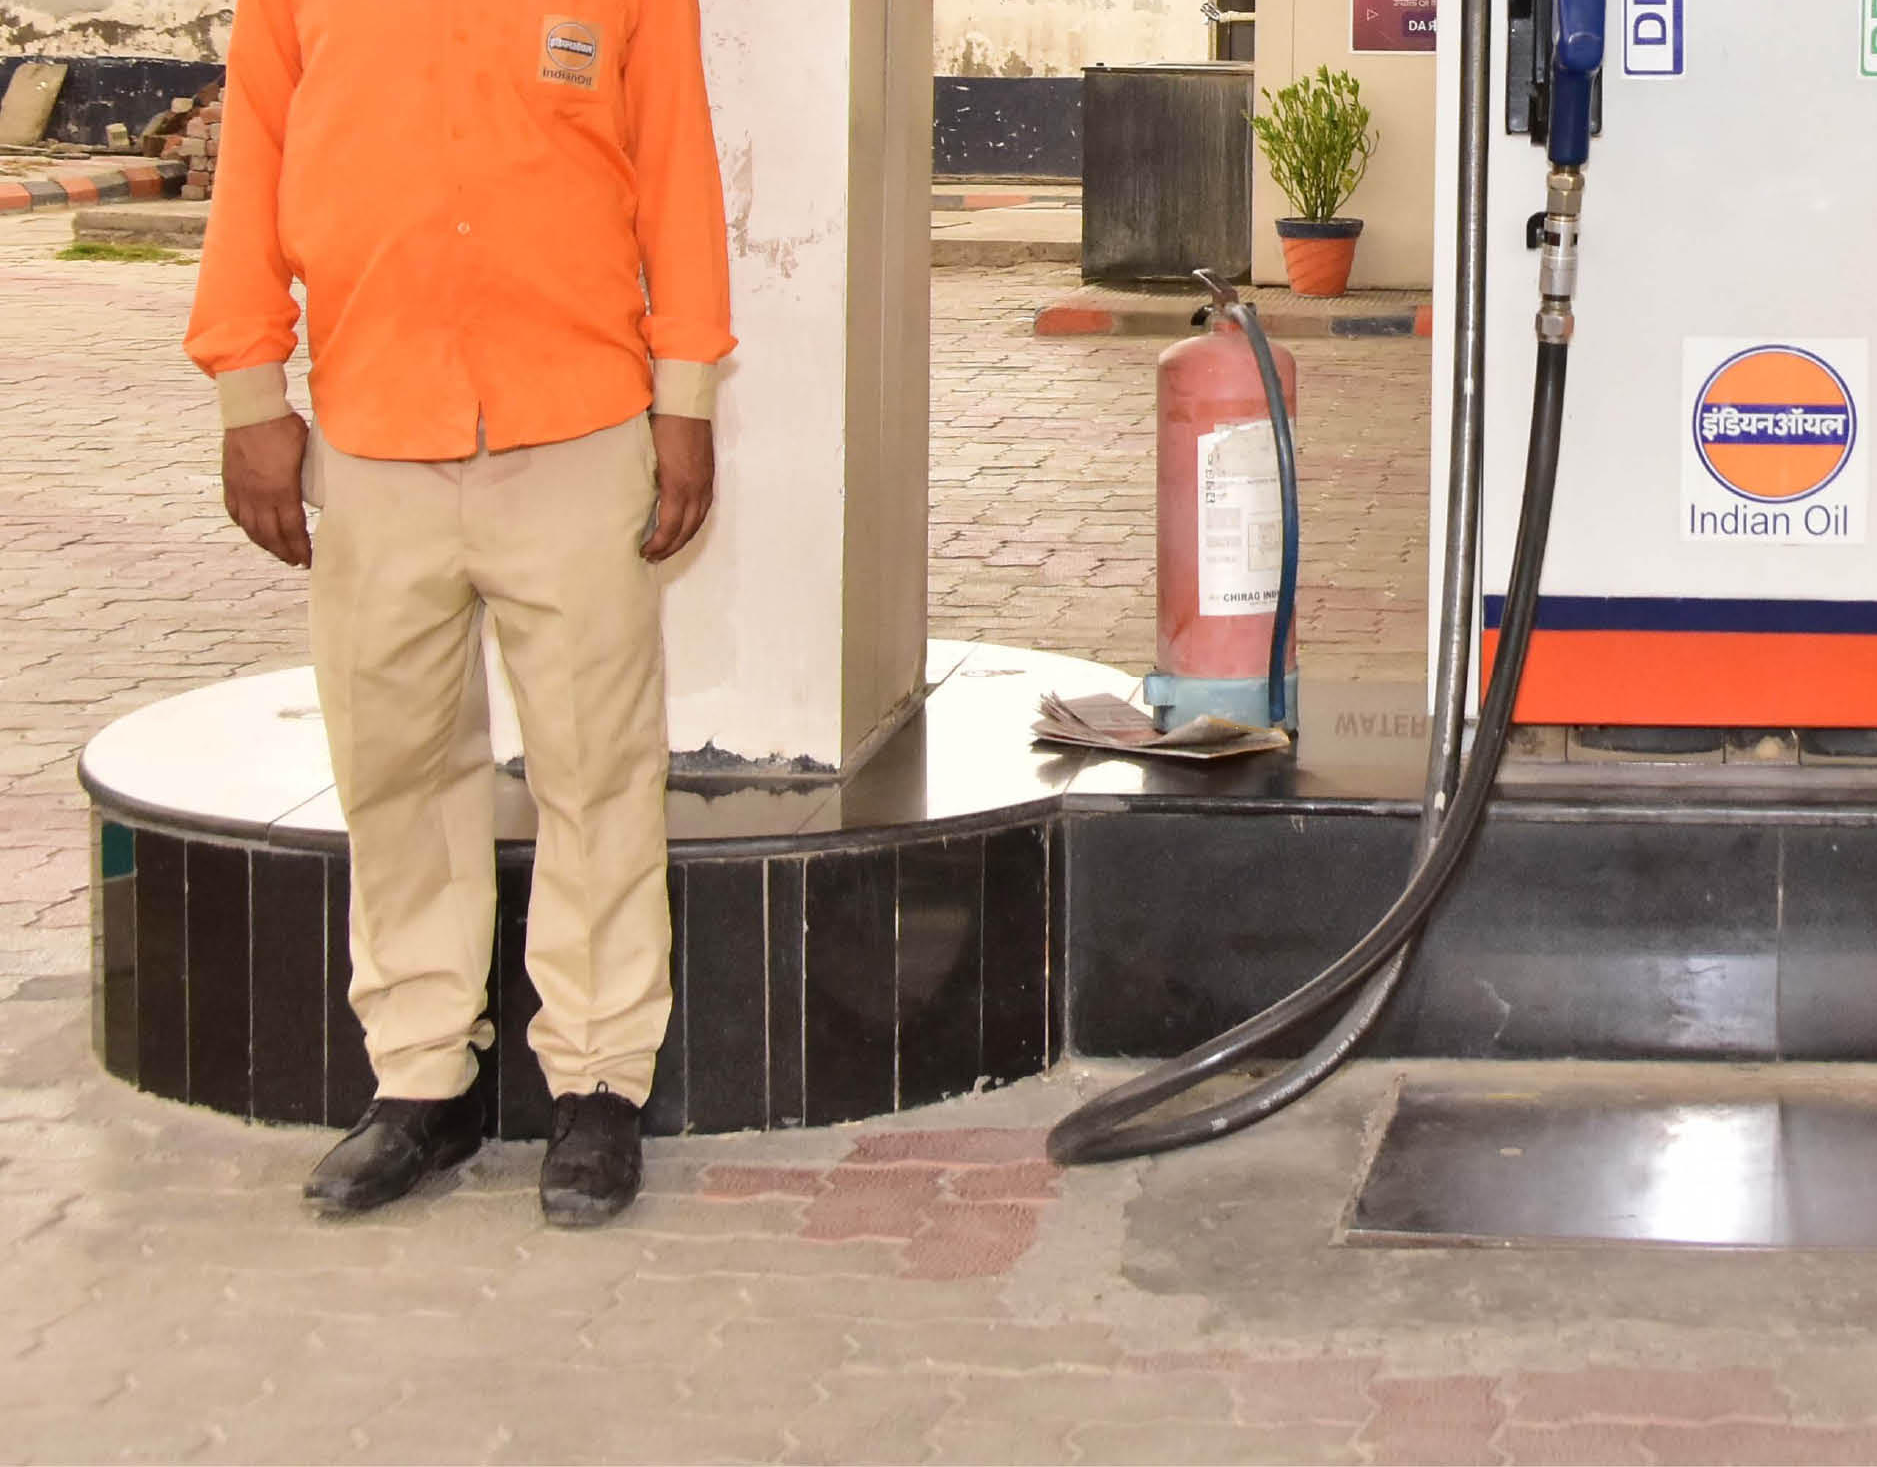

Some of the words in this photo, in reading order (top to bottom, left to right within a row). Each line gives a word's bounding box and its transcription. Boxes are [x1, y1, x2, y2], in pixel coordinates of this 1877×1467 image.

[1702, 407, 1847, 441] इंडियनऑयल
[1690, 503, 1791, 536] Indian
[1804, 504, 1848, 537] Oil
